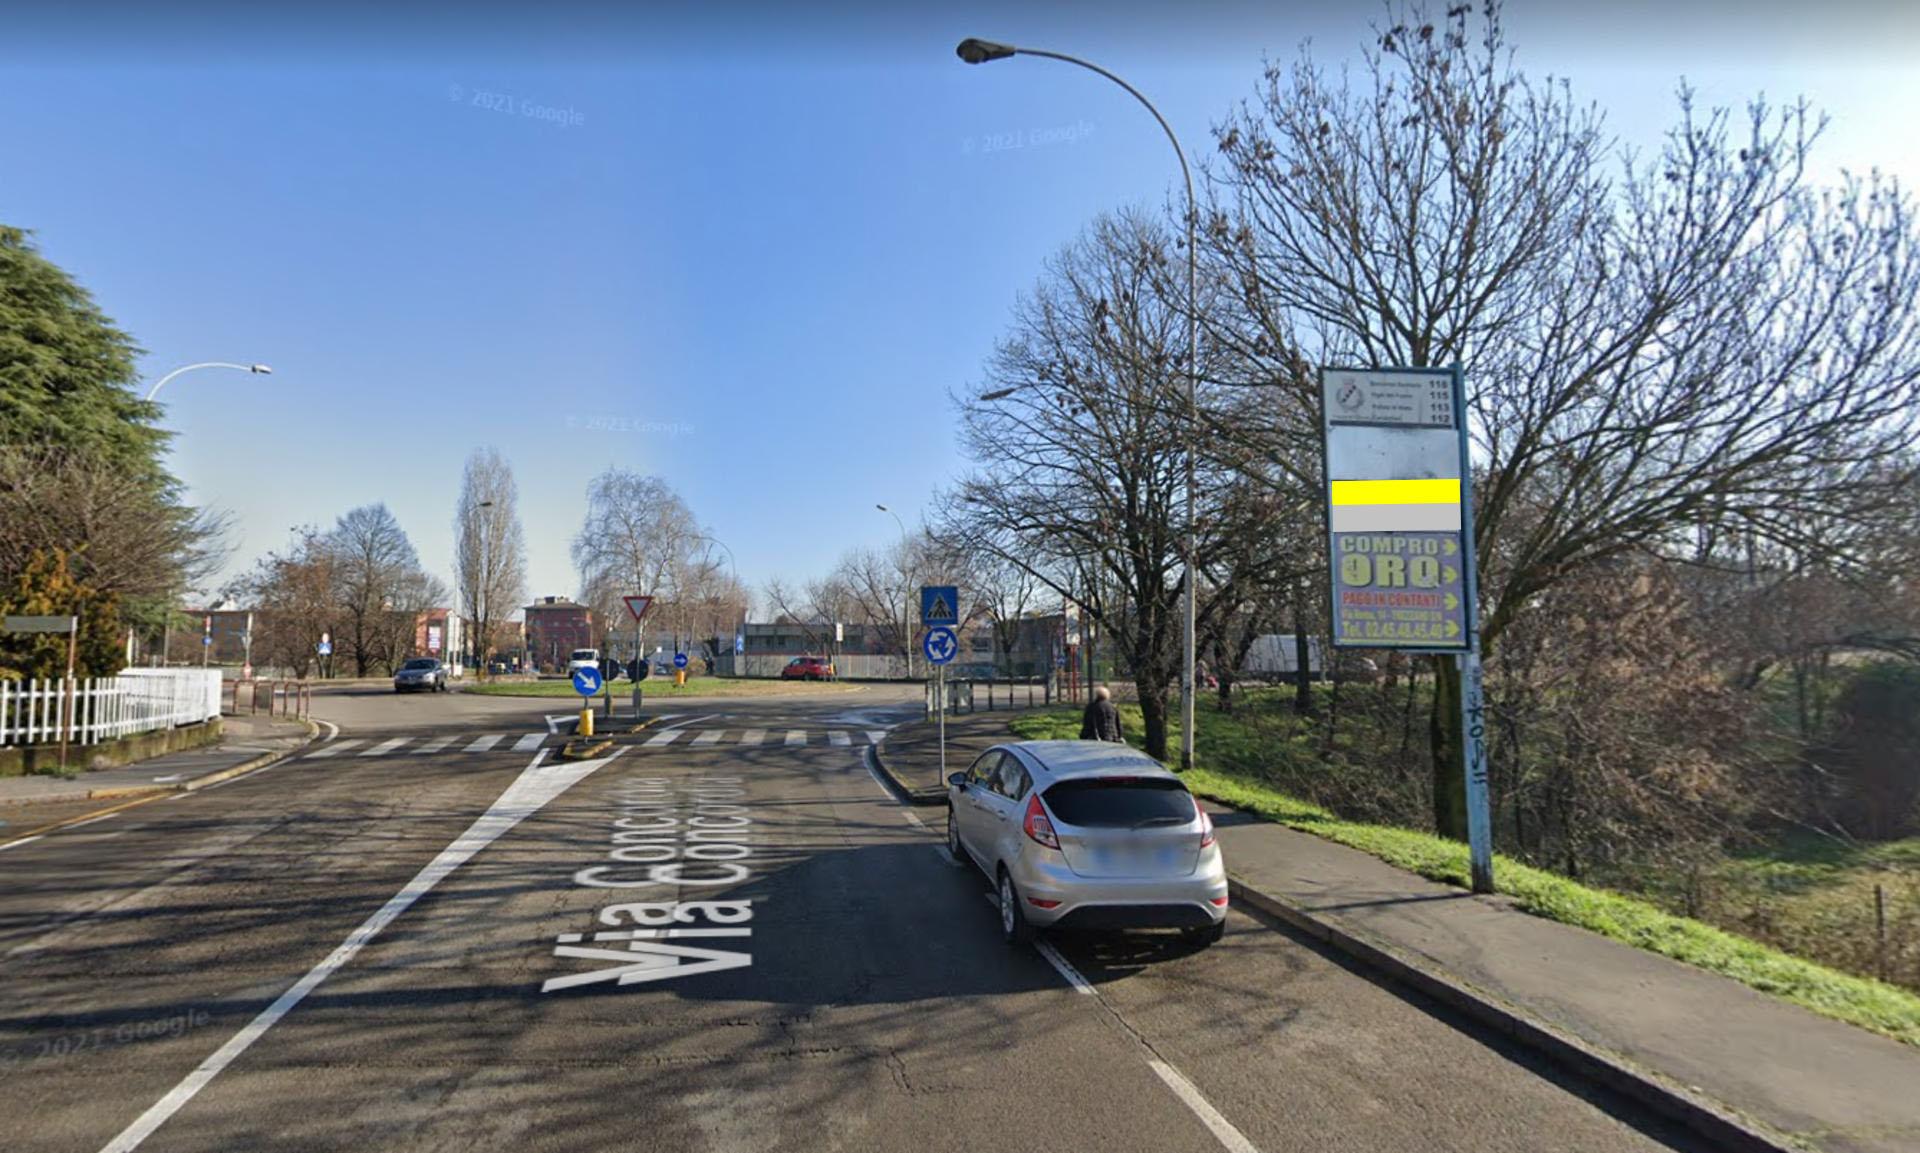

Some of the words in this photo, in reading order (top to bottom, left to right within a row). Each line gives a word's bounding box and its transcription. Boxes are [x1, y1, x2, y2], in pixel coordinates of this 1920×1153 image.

[1431, 414, 1451, 424] 112
[1340, 535, 1439, 555] COMPRO
[1342, 591, 1371, 605] PAGO
